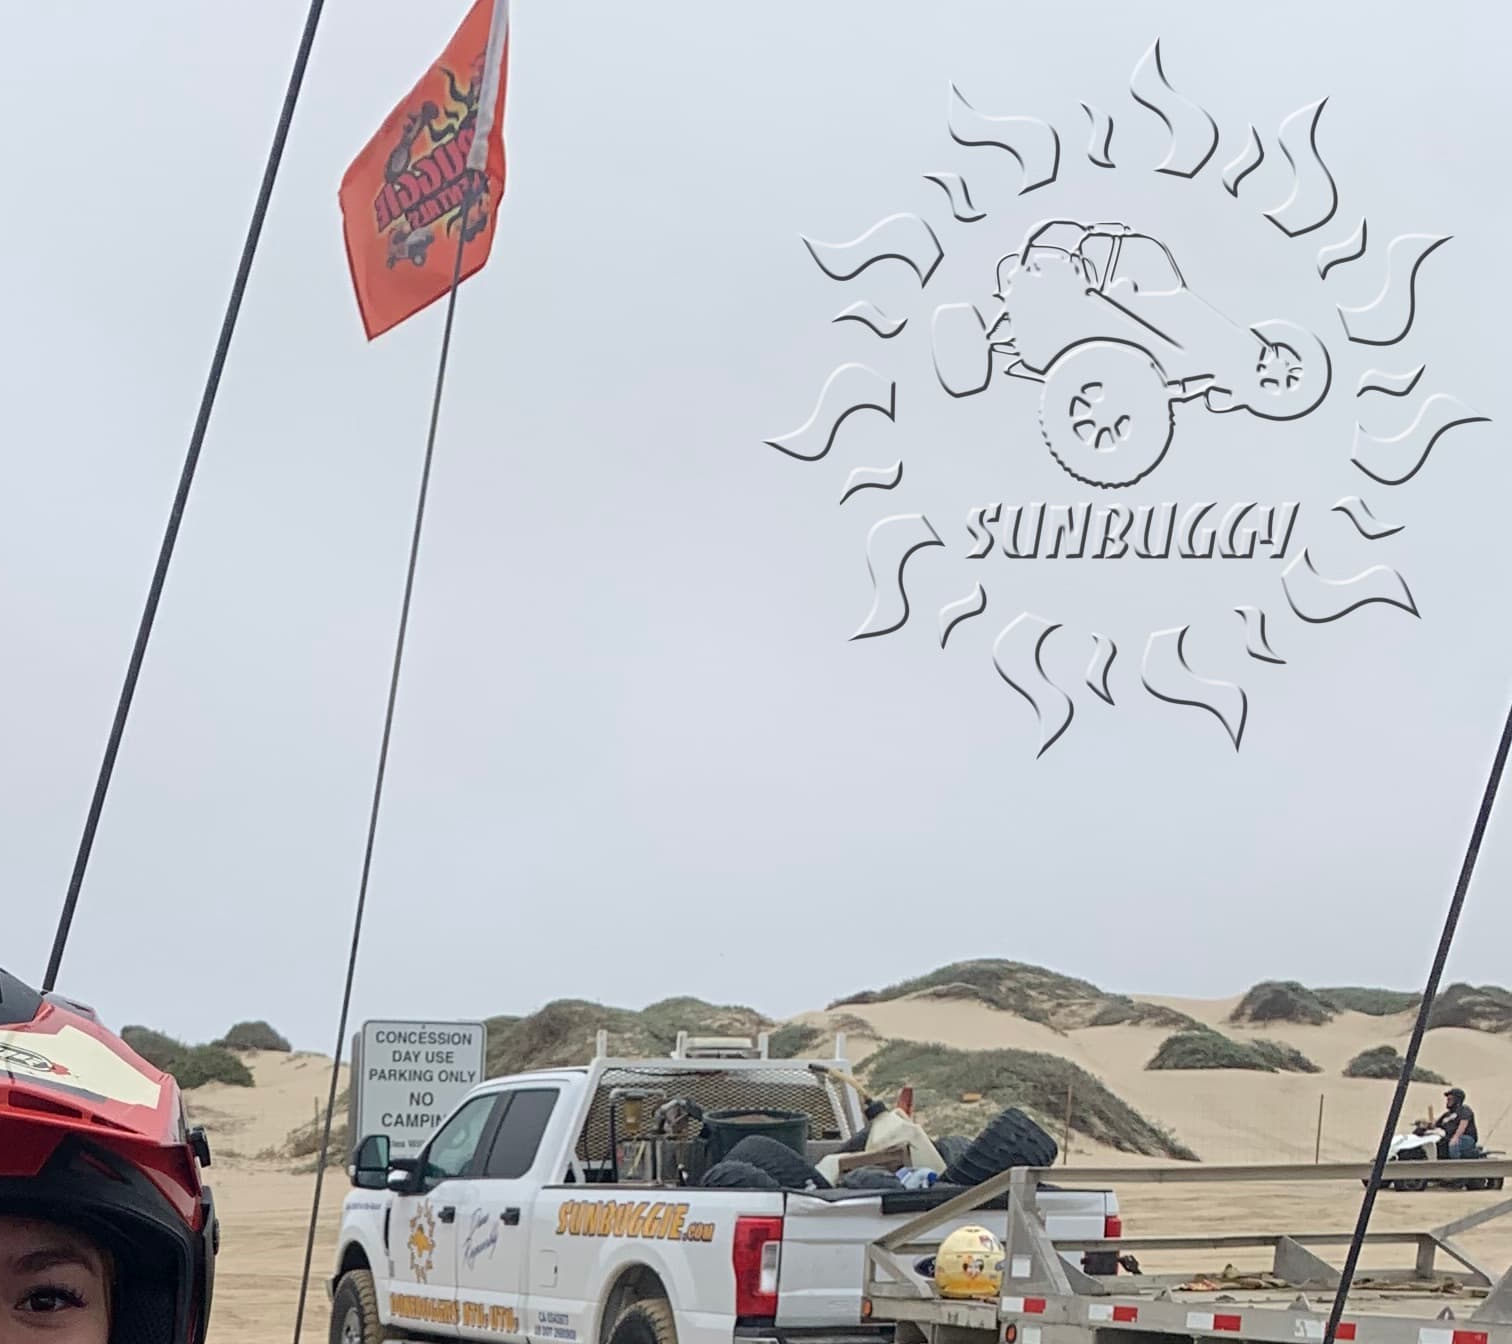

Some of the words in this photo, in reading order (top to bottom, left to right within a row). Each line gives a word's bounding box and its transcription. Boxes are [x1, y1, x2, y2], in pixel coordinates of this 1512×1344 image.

[375, 1031, 473, 1045] CONCESSION
[392, 1050, 421, 1063] DAY
[425, 1051, 454, 1064] USE
[368, 1068, 434, 1082] PARKING
[438, 1070, 476, 1083] ONLY
[409, 1092, 434, 1106] NO
